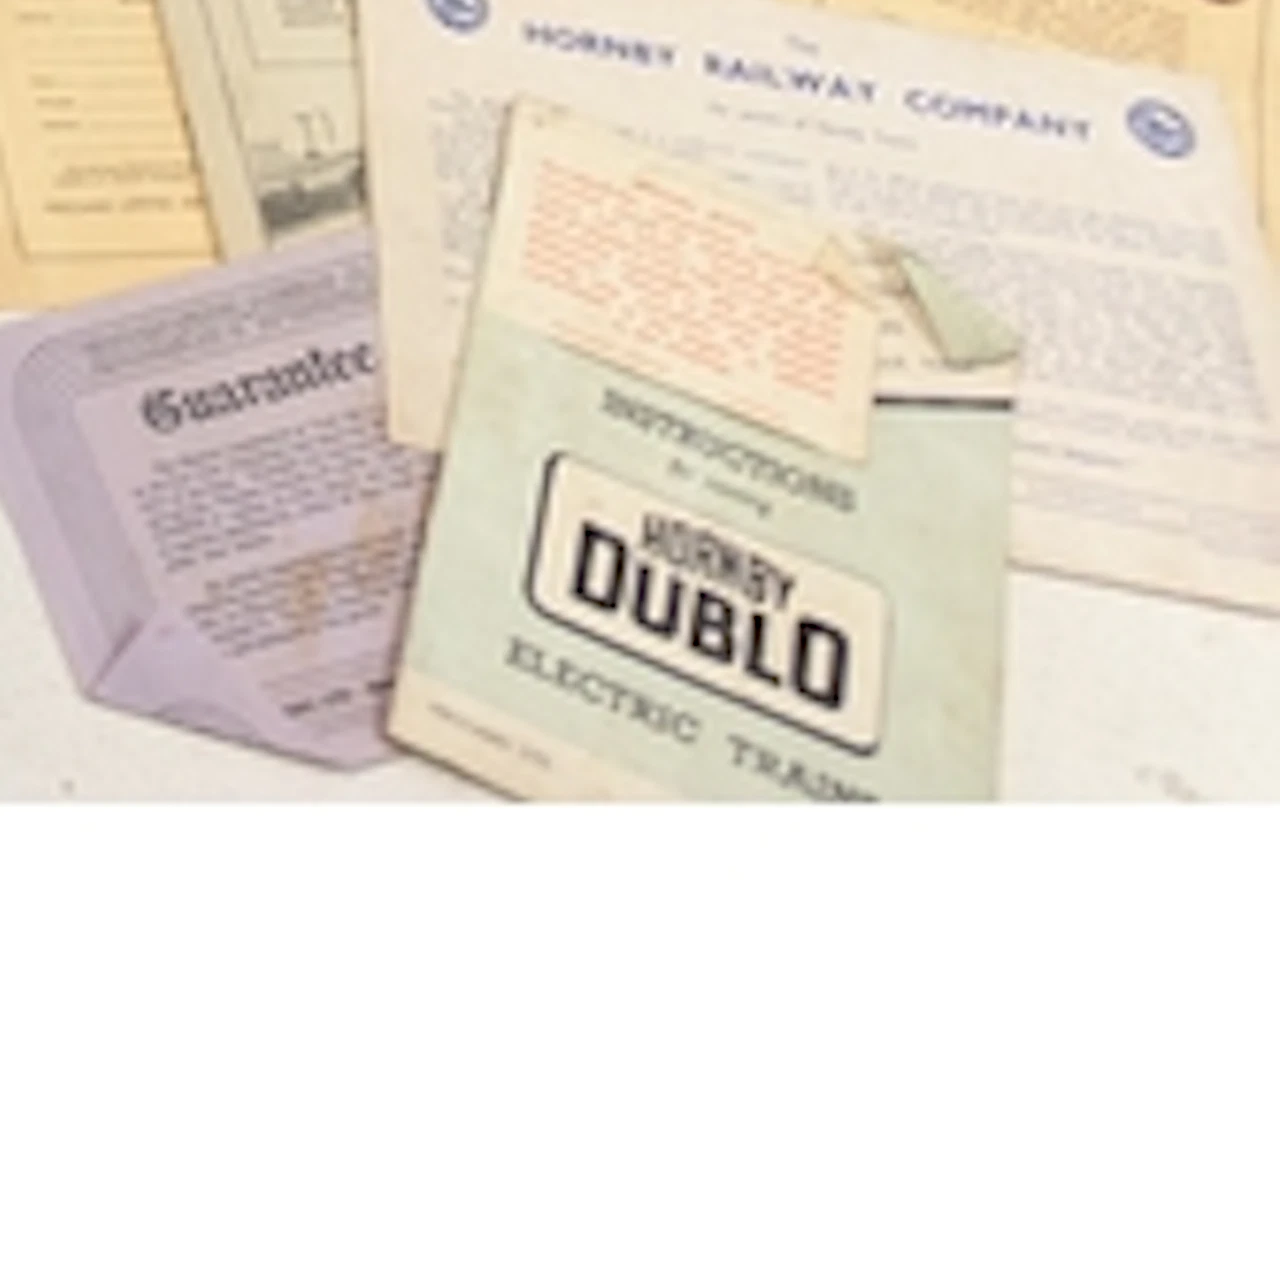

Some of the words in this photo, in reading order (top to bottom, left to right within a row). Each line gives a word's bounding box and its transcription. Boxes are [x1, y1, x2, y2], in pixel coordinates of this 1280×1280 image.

[523, 20, 677, 68] HORNBY
[703, 51, 879, 103] RAILWAY
[904, 86, 1095, 141] COMPANY
[568, 518, 853, 711] DUBLO
[639, 510, 798, 614] HORNBY
[505, 636, 702, 743] ELECTRIC
